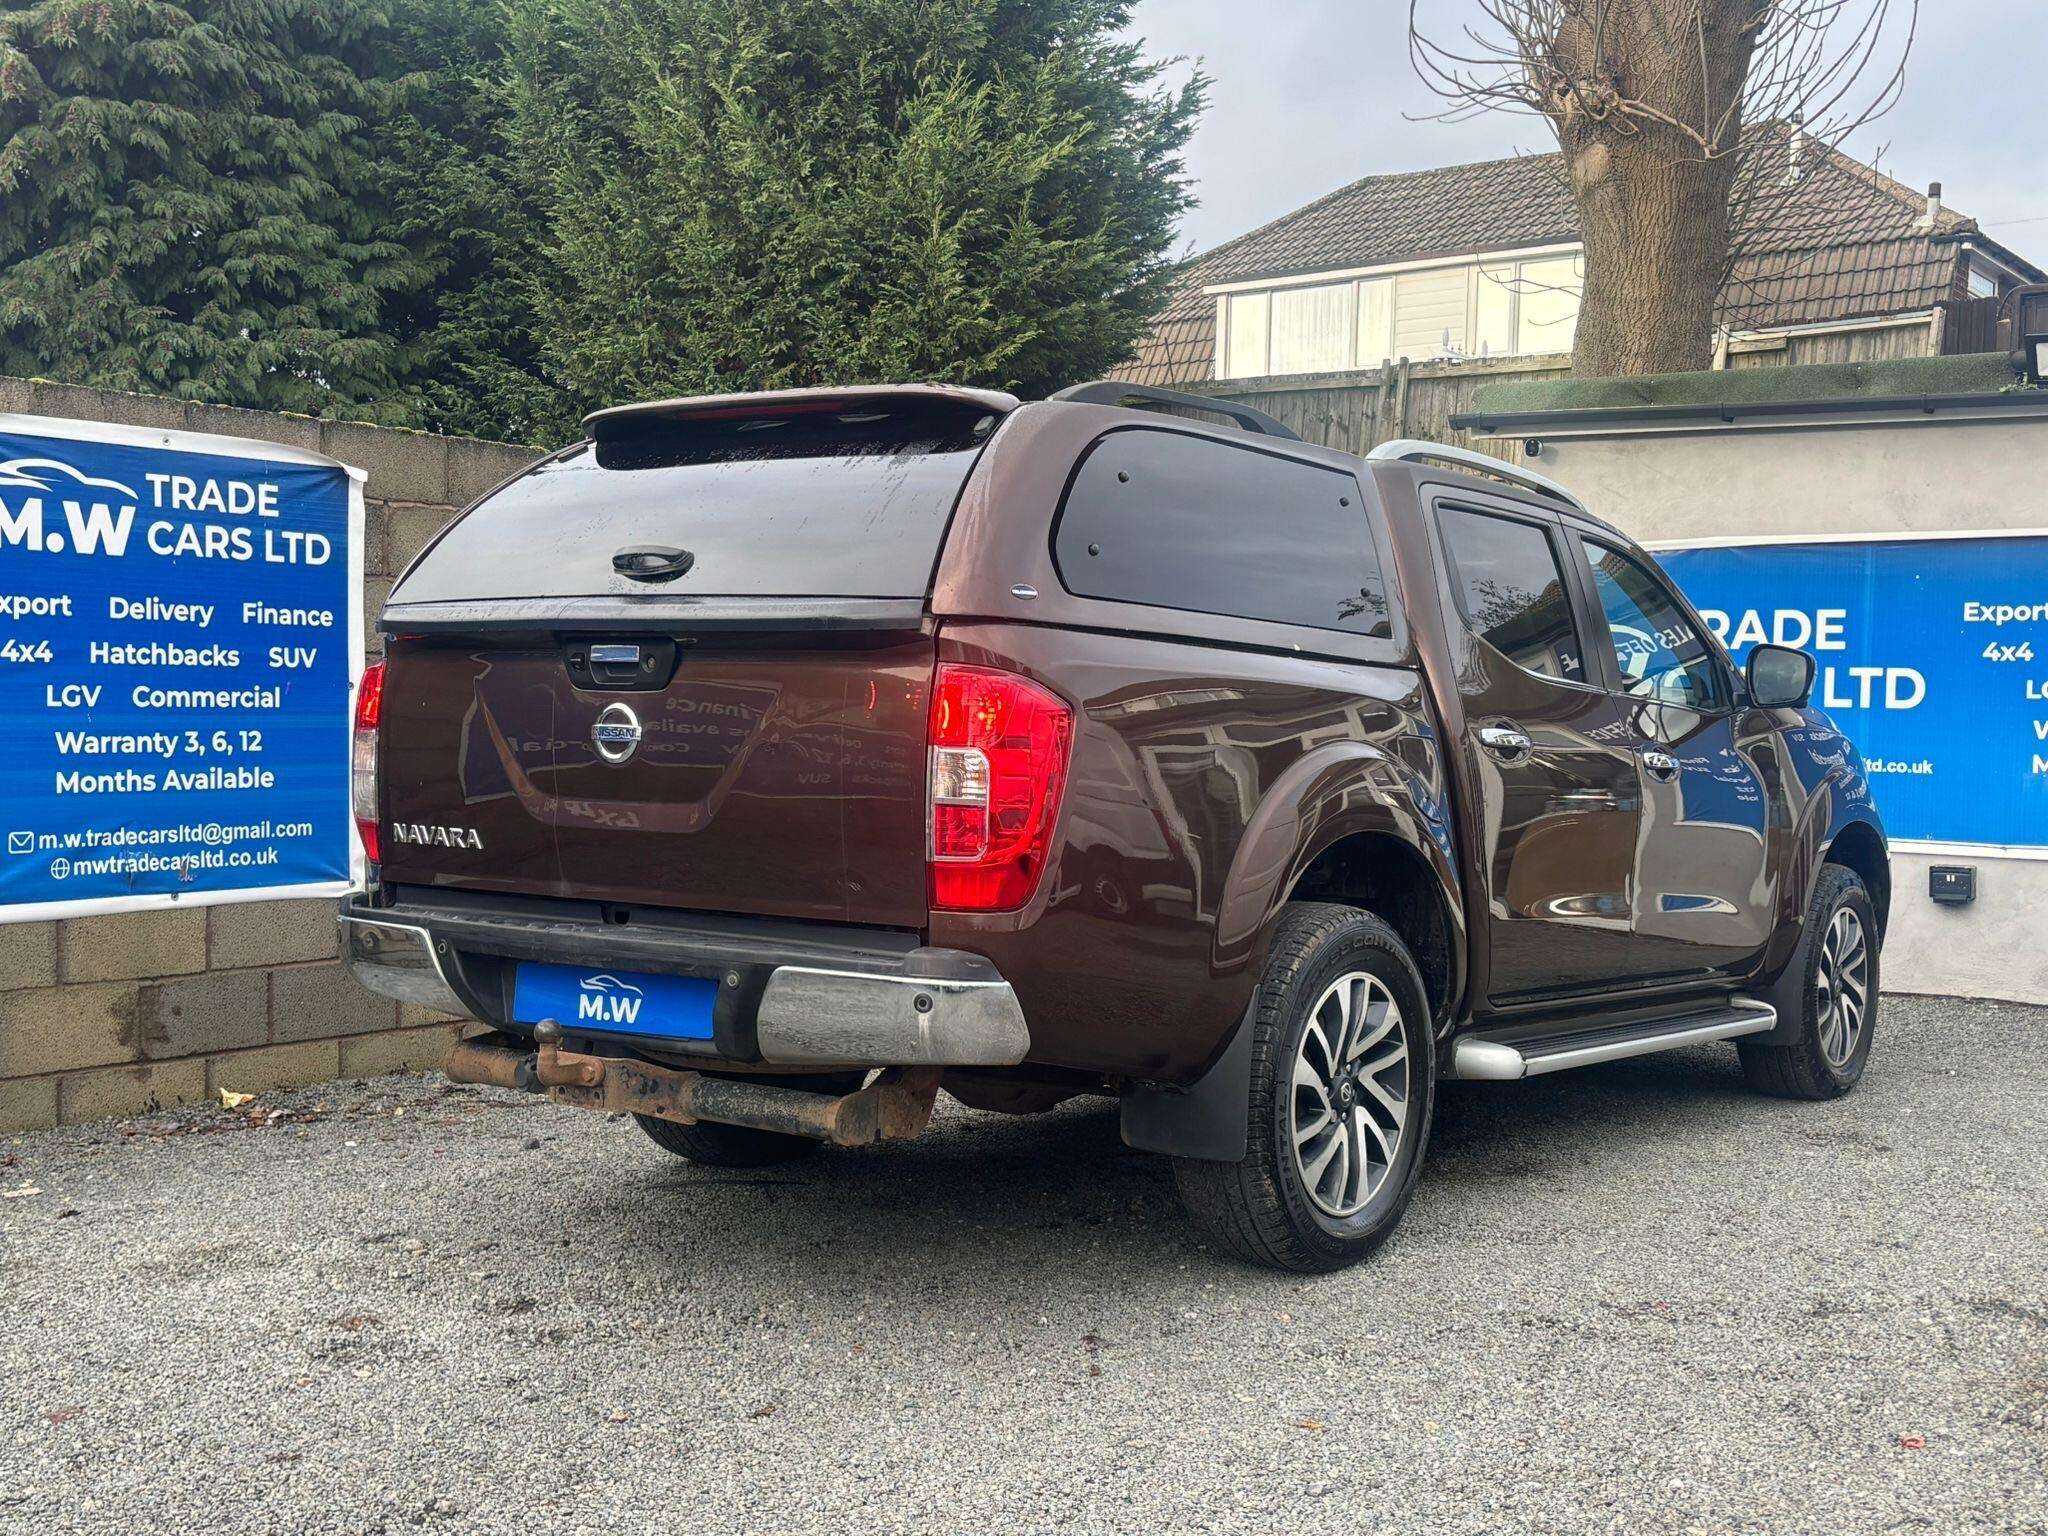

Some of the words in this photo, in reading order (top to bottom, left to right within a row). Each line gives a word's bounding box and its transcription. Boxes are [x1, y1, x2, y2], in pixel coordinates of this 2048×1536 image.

[146, 473, 280, 518] TRADE
[147, 520, 253, 561] CARS
[264, 529, 331, 565] LTD
[0, 595, 73, 620] xport
[109, 596, 215, 628] Delivery
[243, 601, 334, 627] Finance
[1697, 608, 1847, 651] RADE
[0, 639, 54, 663] 4x4
[90, 641, 240, 667] Hatchbacks
[268, 646, 317, 668] SUV
[1982, 641, 2034, 662] 4x4
[46, 684, 102, 708] LGV
[132, 685, 281, 708] Commercial
[1823, 666, 1926, 710] LTD
[55, 731, 179, 758] Warranty
[184, 731, 206, 756] 3,
[212, 730, 233, 756] 6,
[238, 730, 263, 752] 12
[597, 727, 637, 739] NISSAN
[55, 769, 157, 794] Months
[162, 766, 275, 791] Available
[38, 820, 313, 853] m.w.tradecarsltd@gmail.com
[393, 822, 484, 850] NAVARA
[73, 846, 279, 877] mwtradecarsltd.co.uk
[578, 993, 642, 1024] M.W
